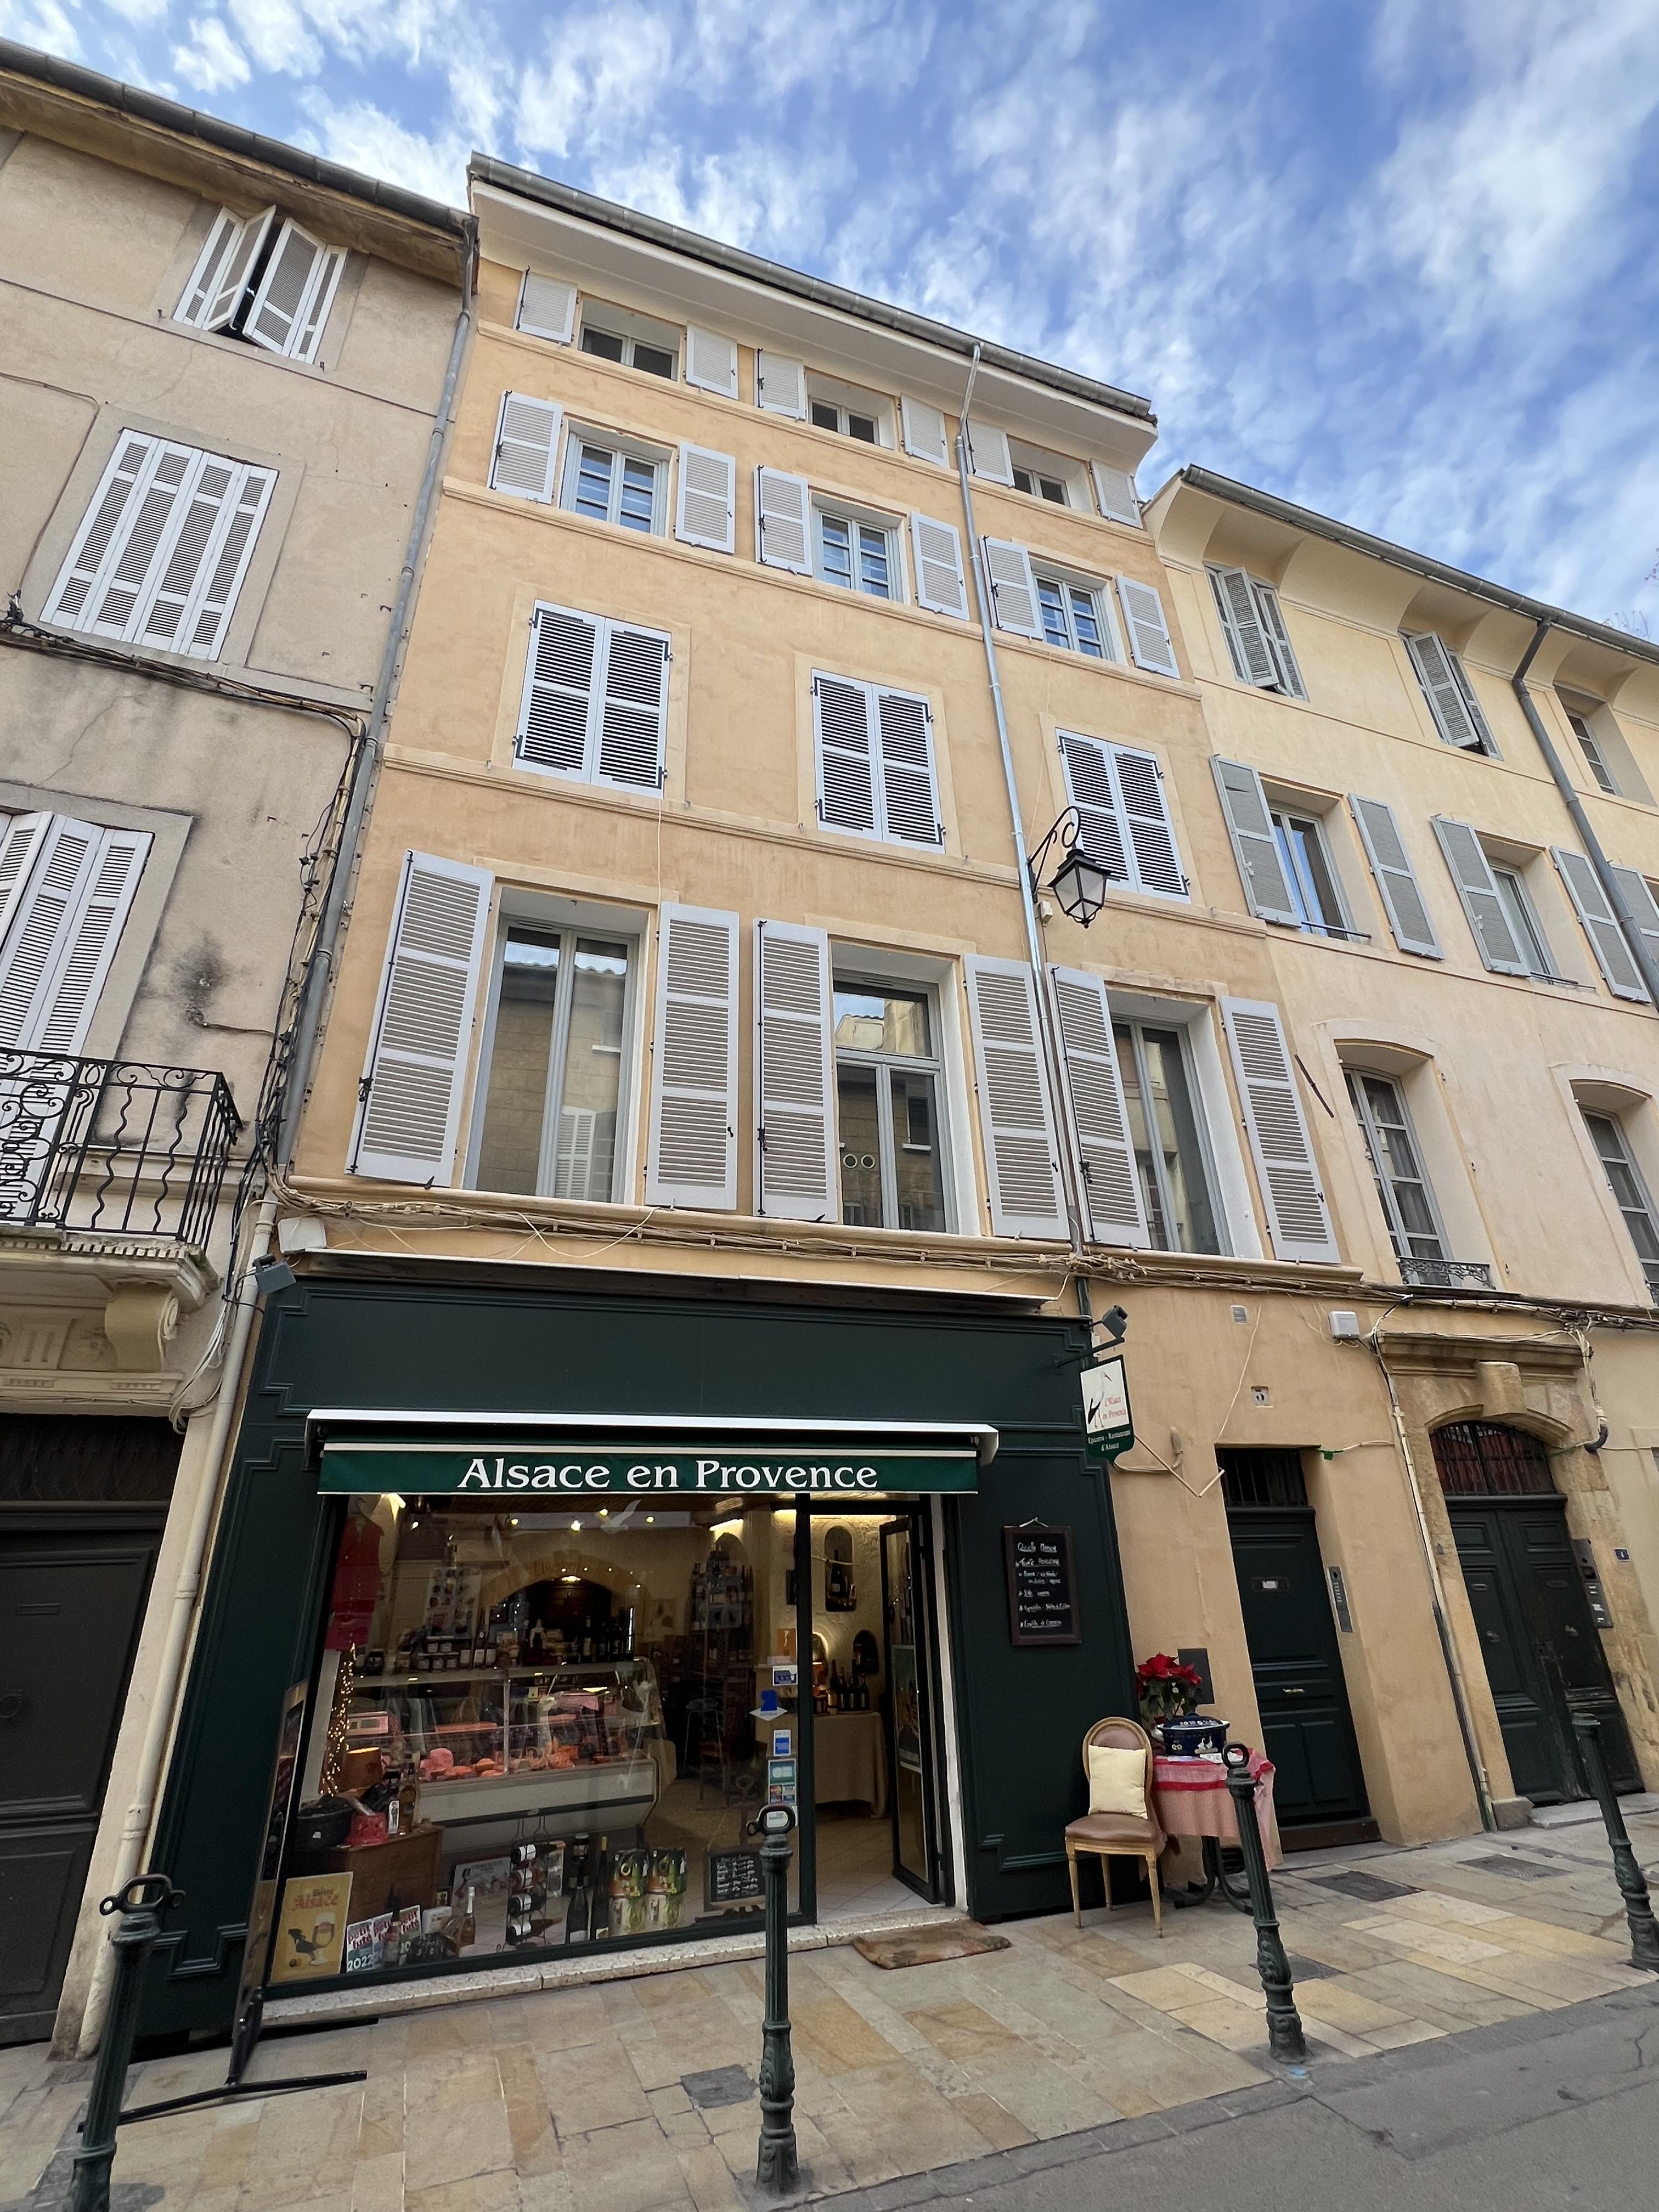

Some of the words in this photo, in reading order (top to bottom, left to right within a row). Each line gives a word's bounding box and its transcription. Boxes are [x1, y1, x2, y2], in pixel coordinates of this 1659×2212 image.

[456, 1458, 611, 1488] Alsace
[627, 1466, 680, 1488] en
[695, 1460, 878, 1488] Provence
[348, 1924, 370, 1944] petit
